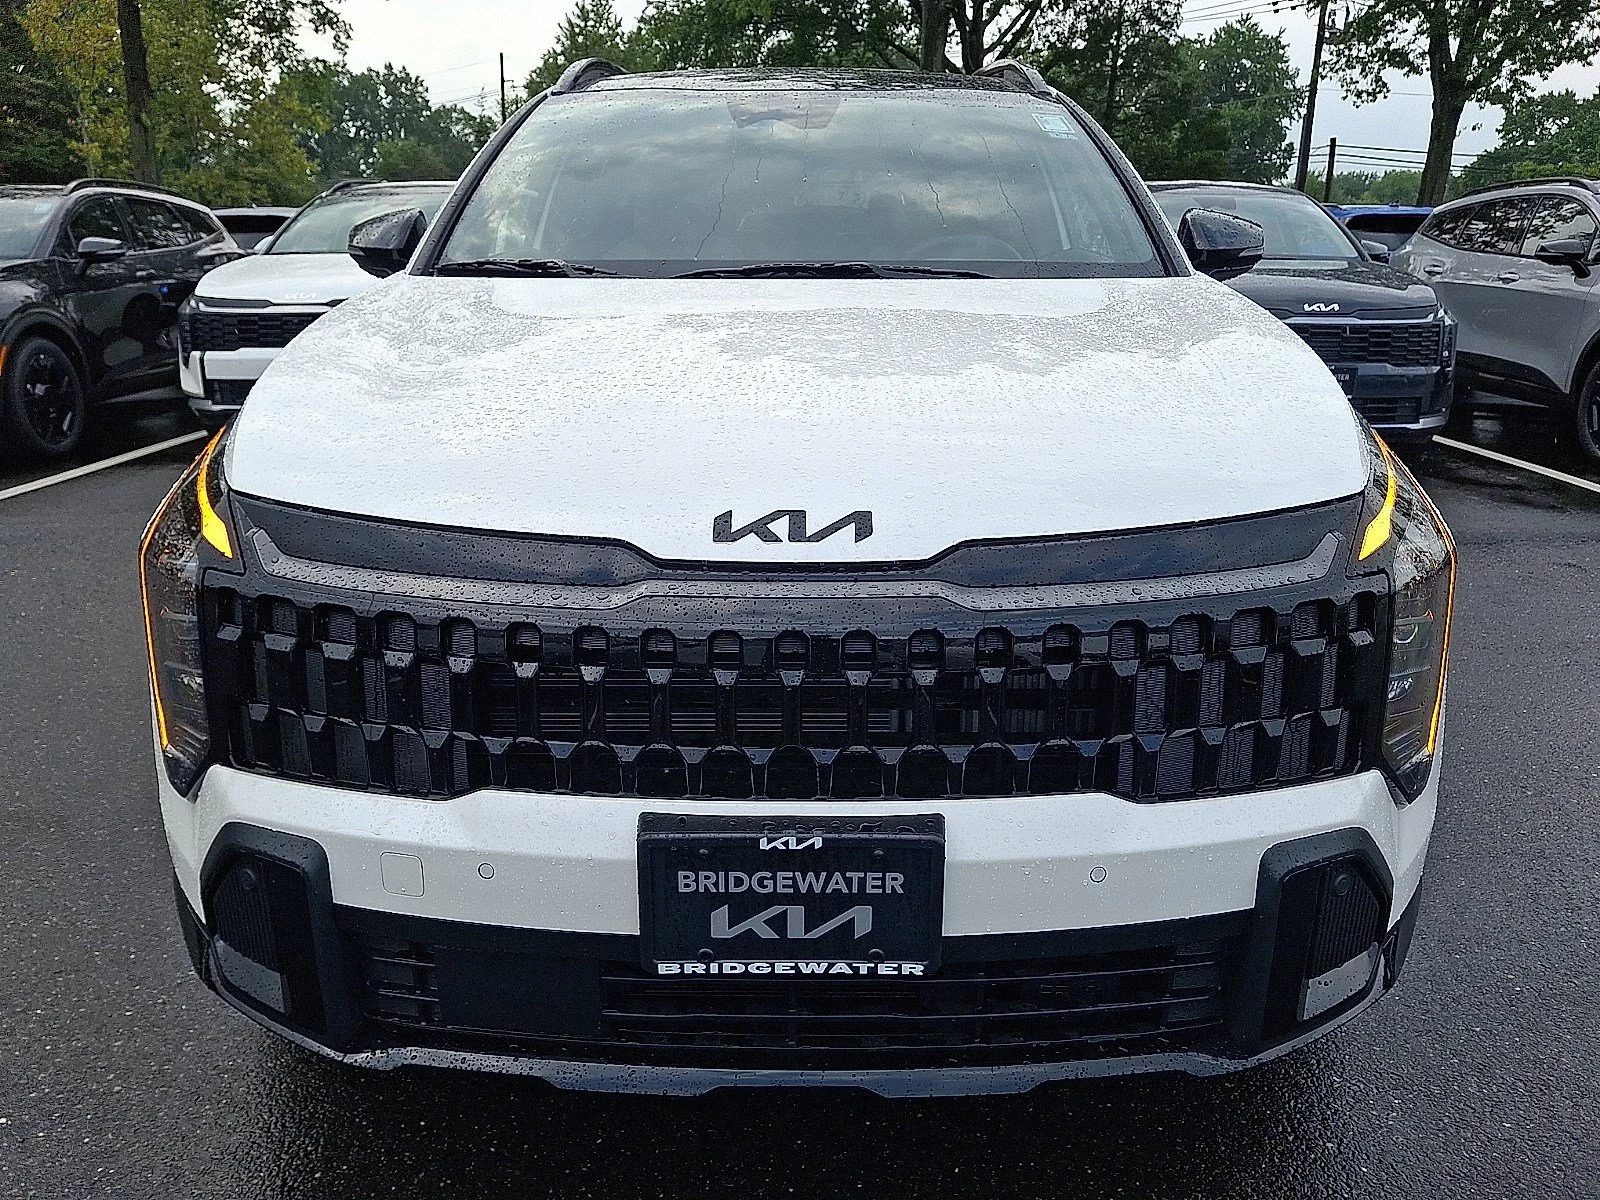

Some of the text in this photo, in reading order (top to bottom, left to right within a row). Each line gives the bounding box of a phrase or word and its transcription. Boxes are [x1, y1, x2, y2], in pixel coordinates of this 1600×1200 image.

[1303, 303, 1340, 312] KIA
[713, 510, 873, 543] KIA
[760, 836, 823, 850] KIA
[677, 870, 905, 894] BRIDGEWATER
[711, 904, 872, 939] KIA
[657, 962, 925, 976] BRIDGEWATER
